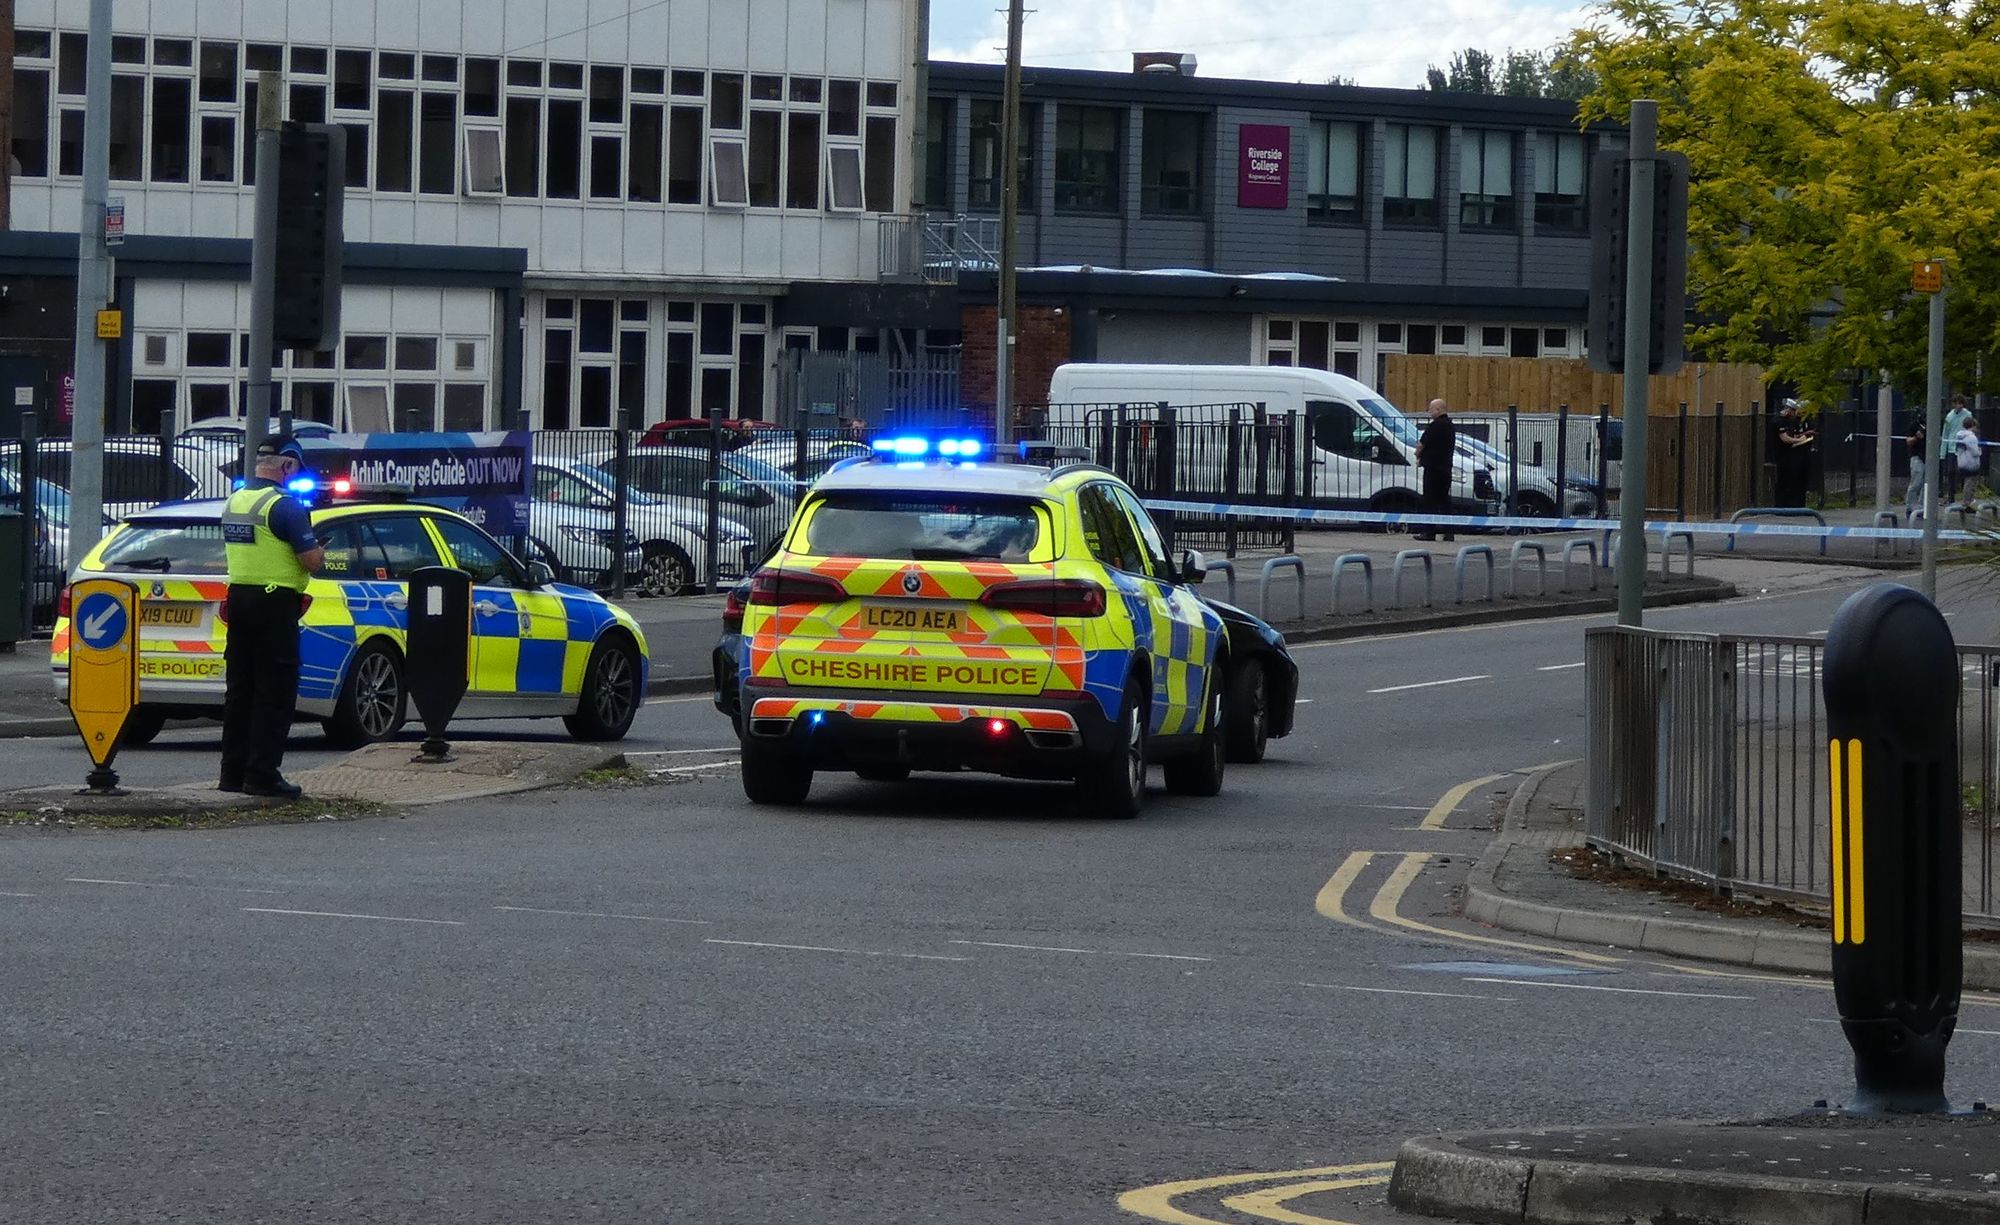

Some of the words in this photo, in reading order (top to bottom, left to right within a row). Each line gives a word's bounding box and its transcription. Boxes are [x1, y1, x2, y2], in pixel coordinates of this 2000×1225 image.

[1248, 147, 1282, 160] Riverside
[1251, 159, 1279, 173] College
[350, 460, 384, 484] Adult
[386, 459, 430, 486] Course
[431, 458, 466, 486] Guide
[466, 457, 491, 485] OUT
[492, 456, 522, 484] NOW
[224, 524, 251, 534] POLICE
[324, 562, 348, 571] POLICE
[164, 608, 193, 624] CUU
[868, 608, 916, 627] LC20
[922, 611, 958, 629] AEA
[790, 657, 928, 683] CHESHIRE
[936, 664, 1039, 686] POLICE
